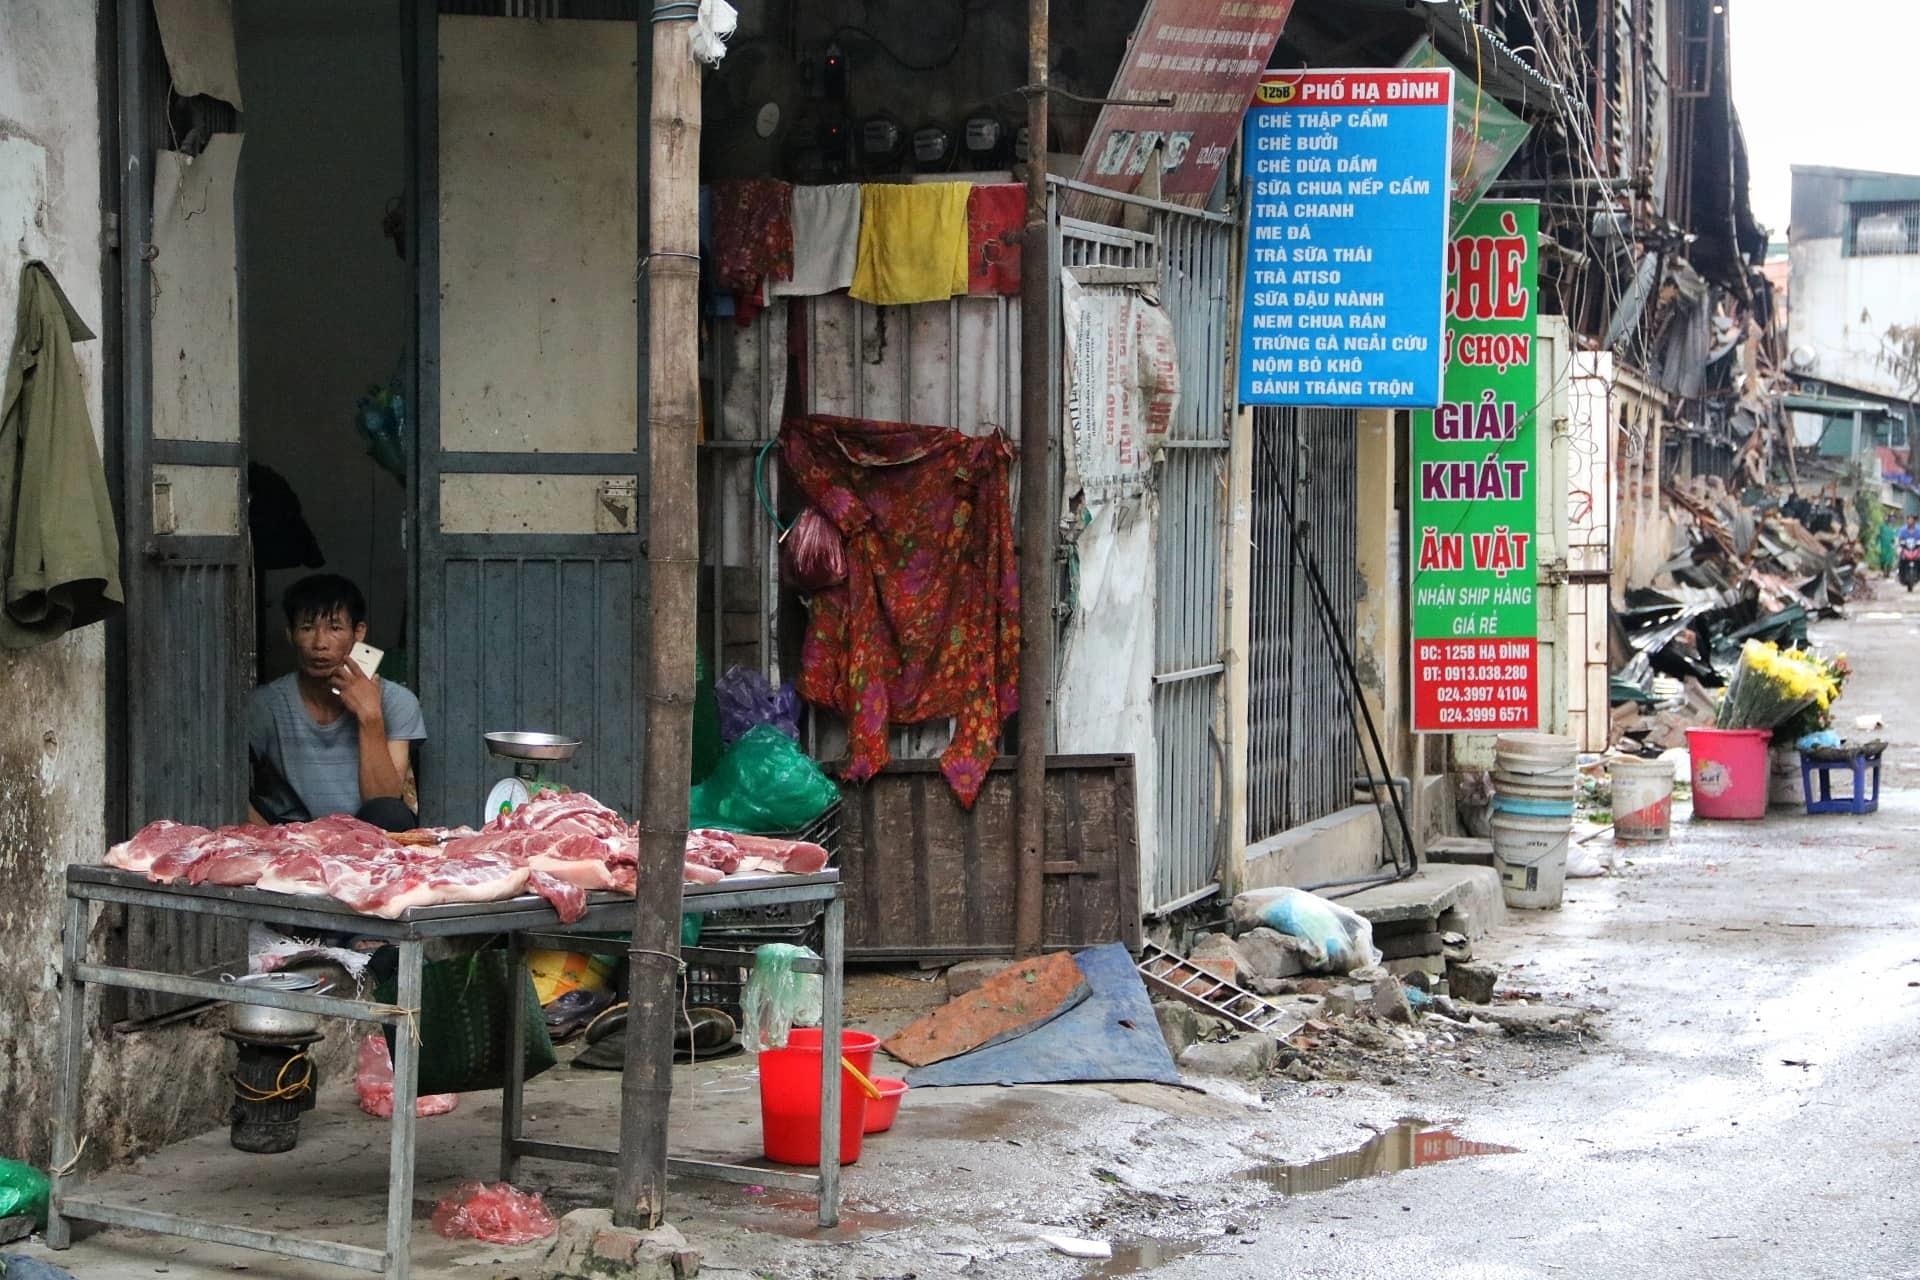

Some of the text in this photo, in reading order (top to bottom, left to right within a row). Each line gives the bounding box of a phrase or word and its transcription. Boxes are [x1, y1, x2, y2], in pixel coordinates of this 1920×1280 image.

[1262, 76, 1439, 102] 125B PHỐ HẠ ĐÌNH
[1297, 111, 1342, 130] THẬP
[1297, 132, 1338, 151] BƯỞI
[1257, 179, 1292, 195] SỮA
[1297, 181, 1343, 195] CHUA
[1348, 177, 1384, 195] NẾP
[1256, 202, 1354, 218] TRÀ CHANH
[1256, 223, 1311, 240] ME ĐÁ
[1255, 246, 1372, 262] TRÀ SỮA THÁI
[1254, 268, 1341, 284] TRÀ ATISO
[1254, 290, 1384, 309] SỮA ĐẬU NÀNH
[1253, 314, 1293, 329] NEM
[1298, 314, 1344, 329] CHUA
[1253, 334, 1310, 351] TRỨNG
[1315, 334, 1339, 351] GÀ
[1391, 334, 1428, 352] CỨU
[1458, 334, 1530, 374] CHỌN
[1252, 356, 1293, 375] NỘM
[1327, 356, 1362, 373] KHÔ
[1252, 378, 1414, 398] BÁNH TRÁNG TRỘN
[1433, 389, 1516, 441] GIẢI
[1421, 453, 1528, 501] KHÁT
[1418, 525, 1530, 578] ĂN VẶT
[1417, 582, 1532, 609] NHẬN SHIP HÀNG
[1452, 612, 1476, 635] GIÁ
[1445, 645, 1476, 660] 125B
[1479, 644, 1497, 663] HẠ
[1499, 641, 1530, 660] ĐÌNH
[1444, 665, 1528, 681] 0913.038.280
[1437, 685, 1528, 702] 024.3997 4104
[1439, 707, 1529, 723] 024.3999 6571
